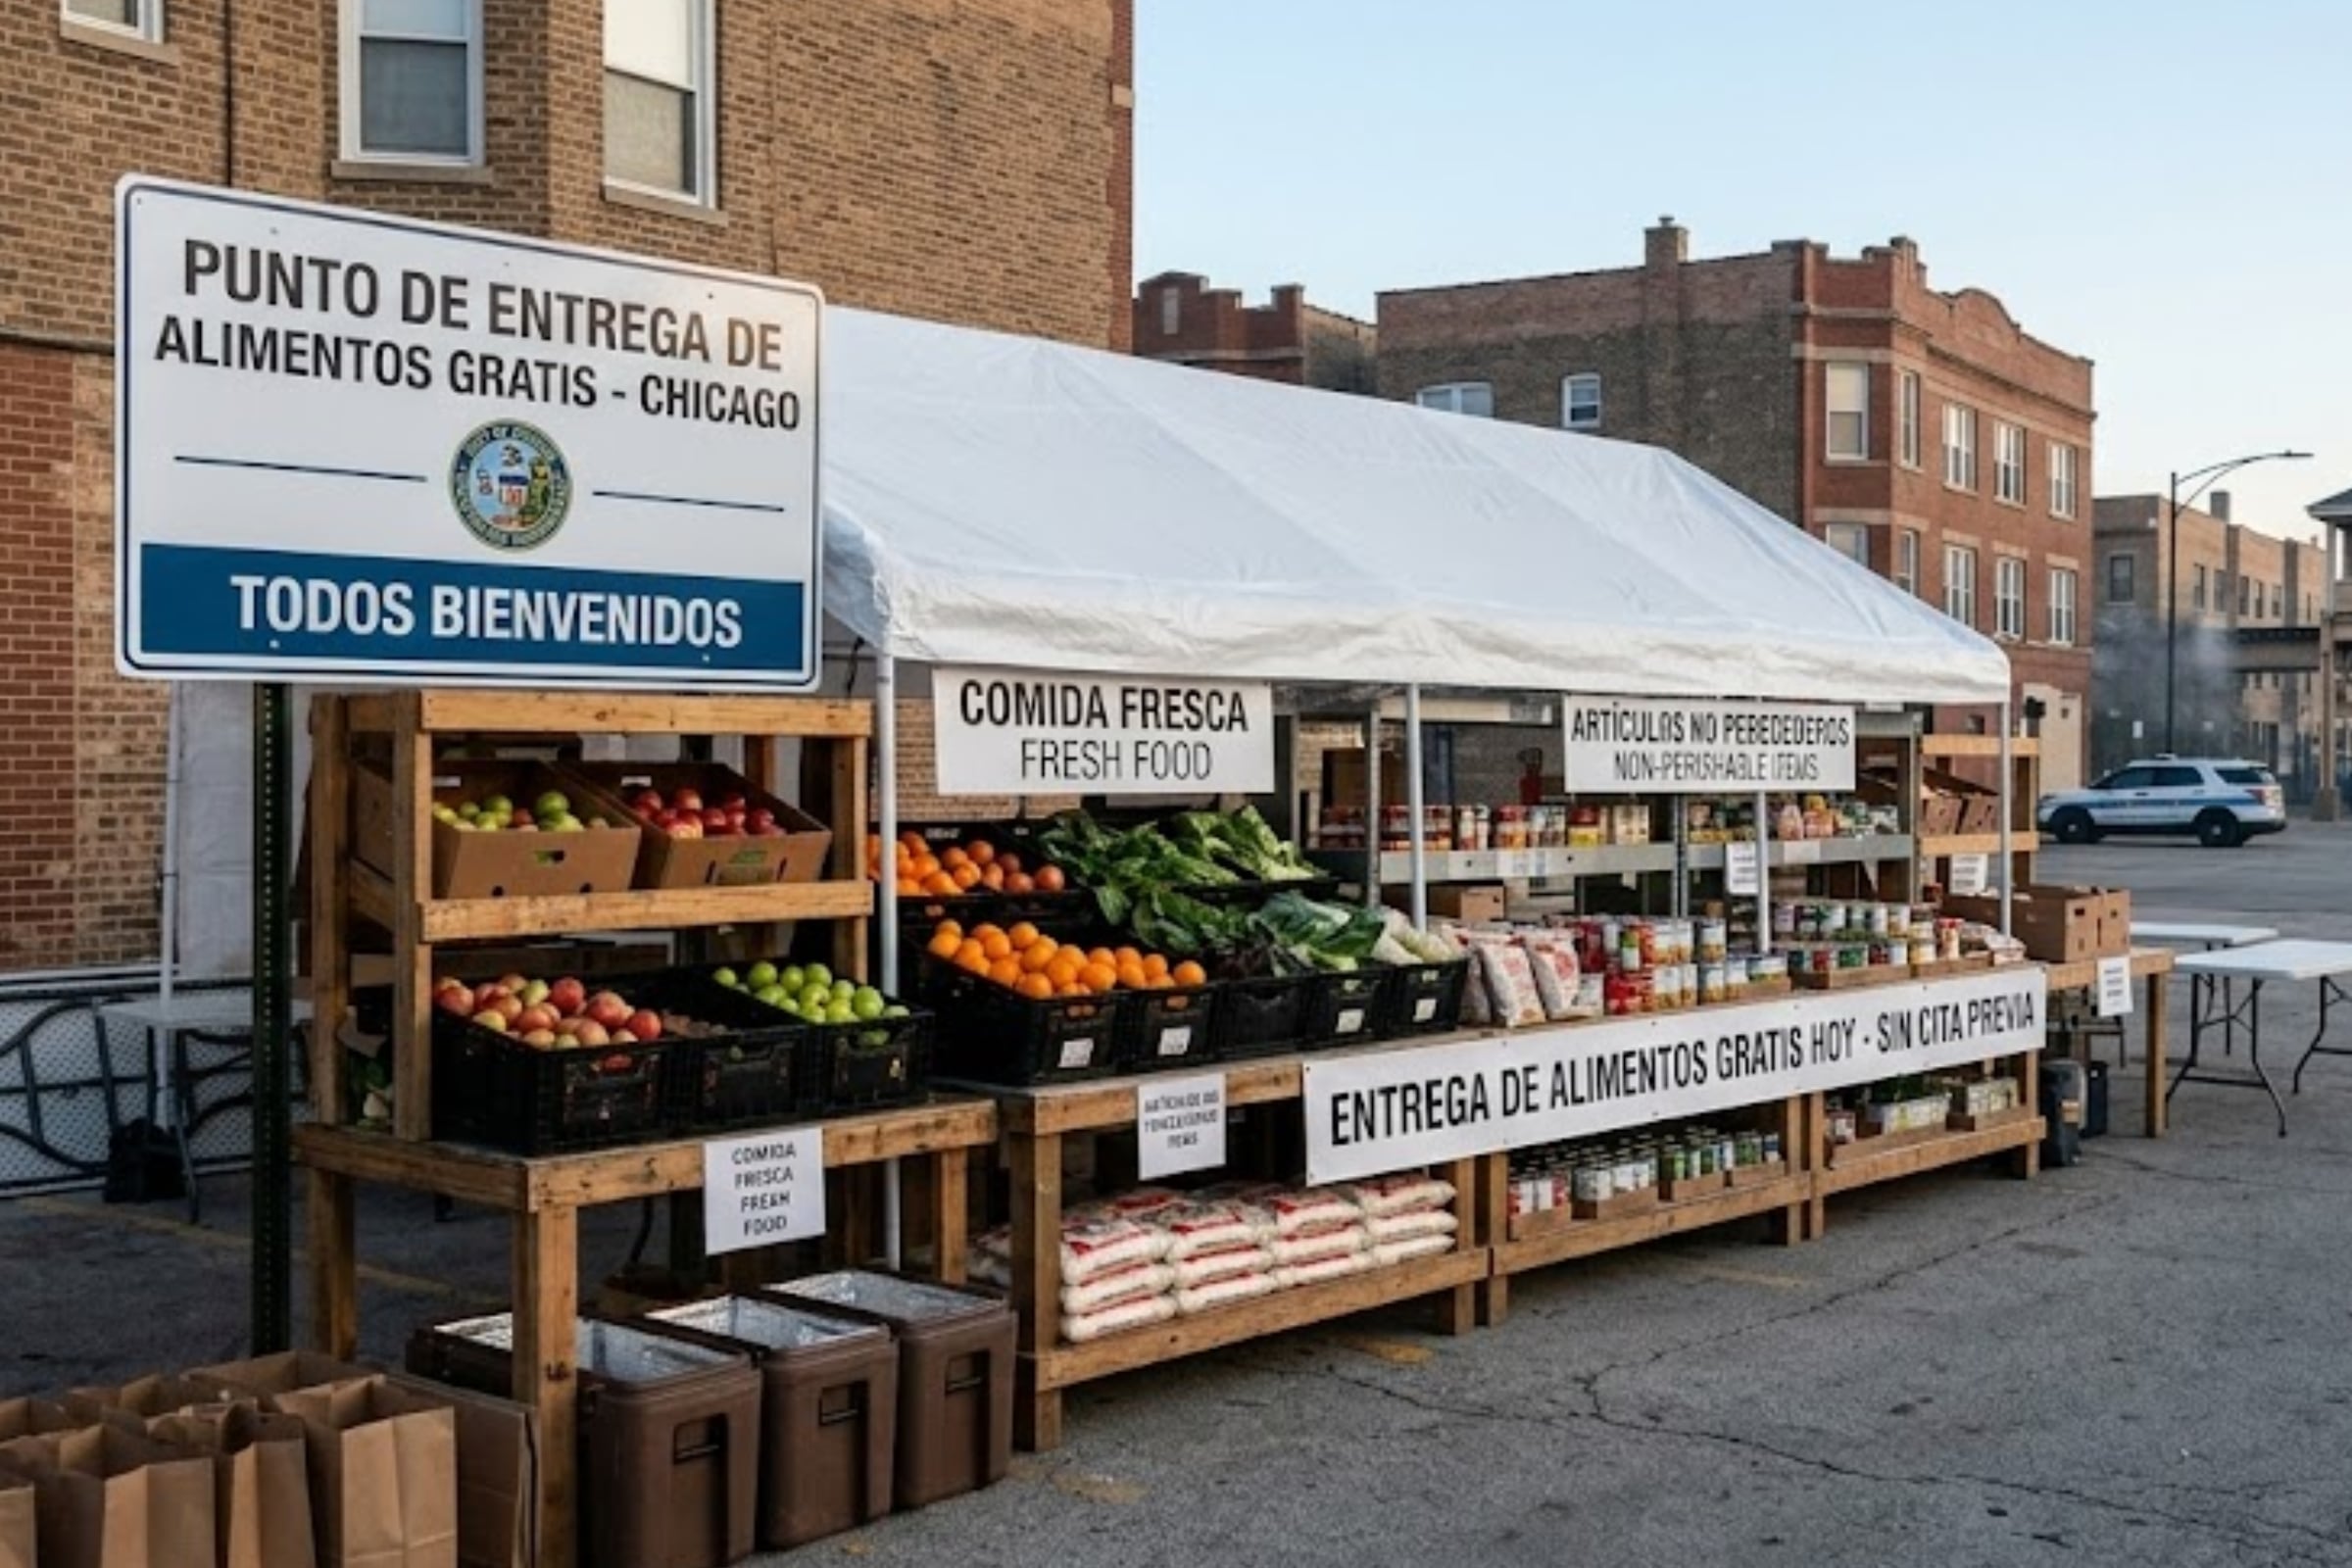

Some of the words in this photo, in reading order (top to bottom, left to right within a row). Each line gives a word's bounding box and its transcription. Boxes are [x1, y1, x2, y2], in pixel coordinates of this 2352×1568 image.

[184, 238, 379, 319] PUNTO
[400, 270, 469, 330] DE
[489, 280, 711, 364] ENTREGA
[727, 317, 782, 371] DE
[153, 314, 432, 390] ALIMENTOS
[449, 349, 597, 408] GRATIS
[612, 390, 626, 400] -
[640, 373, 801, 431] CHICAGO
[229, 574, 416, 637] TODOS
[430, 584, 743, 648] BIENVENIDOS
[959, 679, 1109, 729] COMIDA
[1121, 686, 1250, 733] FRESCA
[1690, 710, 1718, 744] NO
[1020, 738, 1123, 780] FRESH
[1134, 740, 1213, 780] FOOD
[1331, 1072, 1491, 1147] ENTREGA
[1500, 1064, 1541, 1117] DE
[1550, 1037, 1708, 1109] ALIMENTOS
[1716, 1026, 1803, 1081] GRATIS
[1810, 1017, 1857, 1065] HOY
[1877, 1011, 1912, 1054] SIN
[1919, 1004, 1963, 1047] CITA
[1968, 991, 2034, 1039] PREVIA
